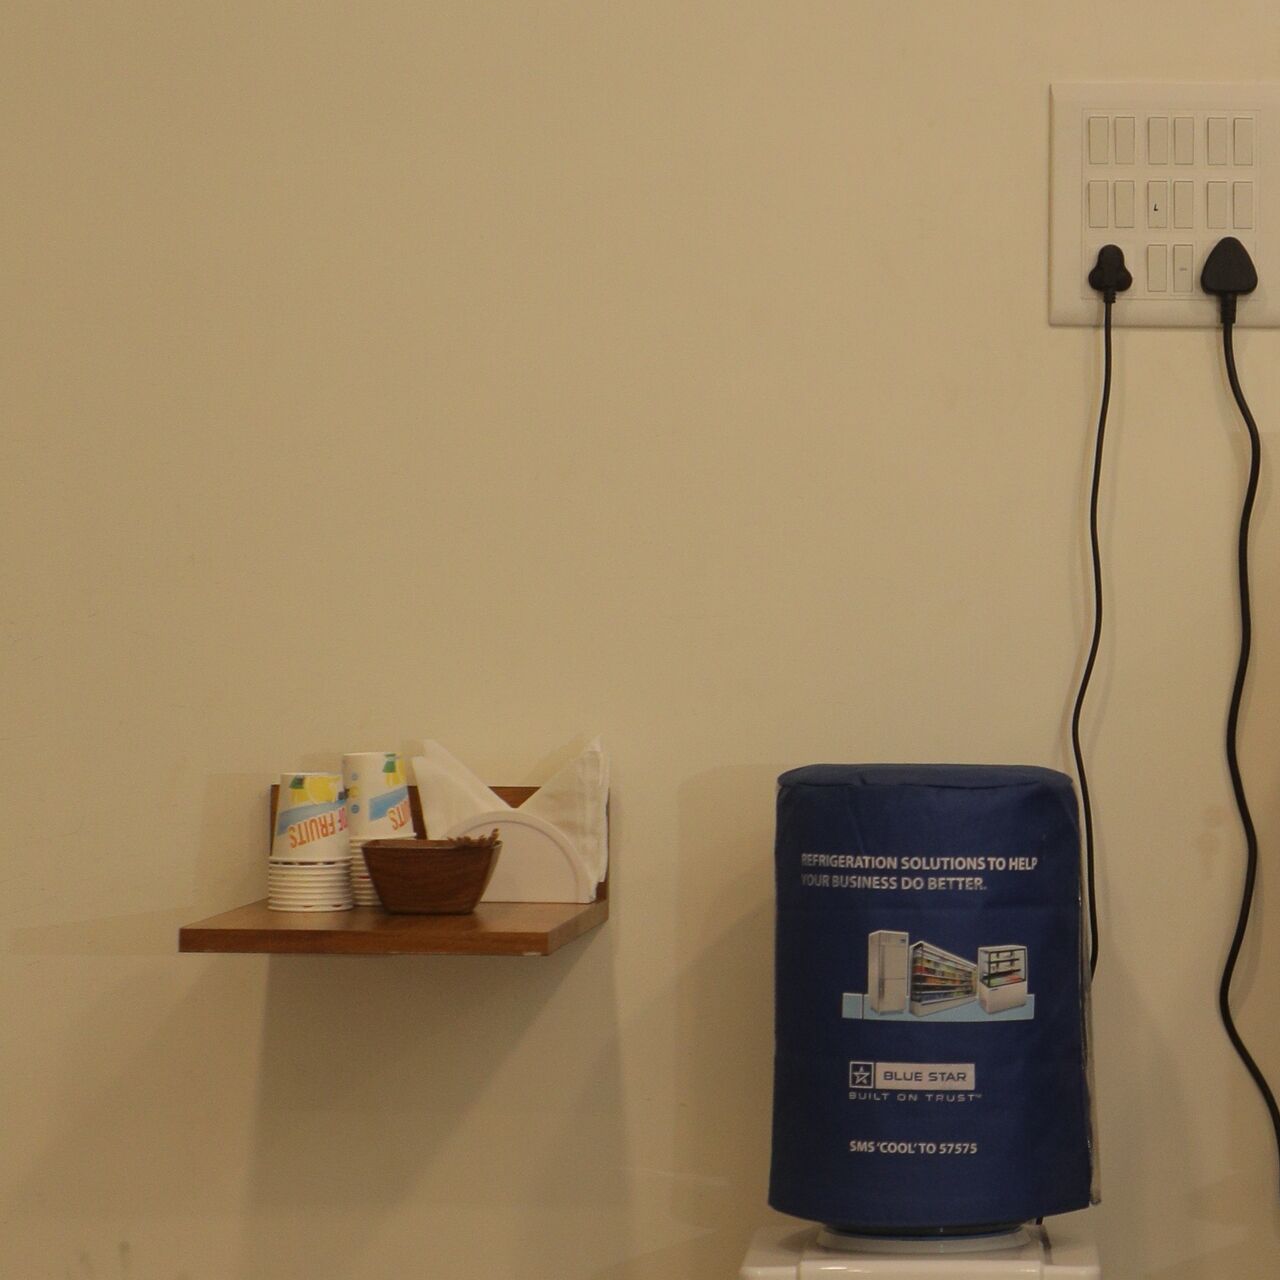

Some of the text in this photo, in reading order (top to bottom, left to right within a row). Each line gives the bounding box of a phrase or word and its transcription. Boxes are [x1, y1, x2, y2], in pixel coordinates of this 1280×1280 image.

[288, 811, 336, 849] FRUITS
[801, 853, 1038, 871] REFRIGERATION SOLUTIONS TO HELP
[800, 873, 988, 890] YOUR BUSINESS DO BETTER.
[883, 1071, 967, 1082] BLUE STAR
[848, 1092, 891, 1100] BUILT
[897, 1093, 918, 1101] ON
[850, 1141, 875, 1152] SMS
[918, 1143, 937, 1154] TO
[939, 1143, 978, 1154] 57575
